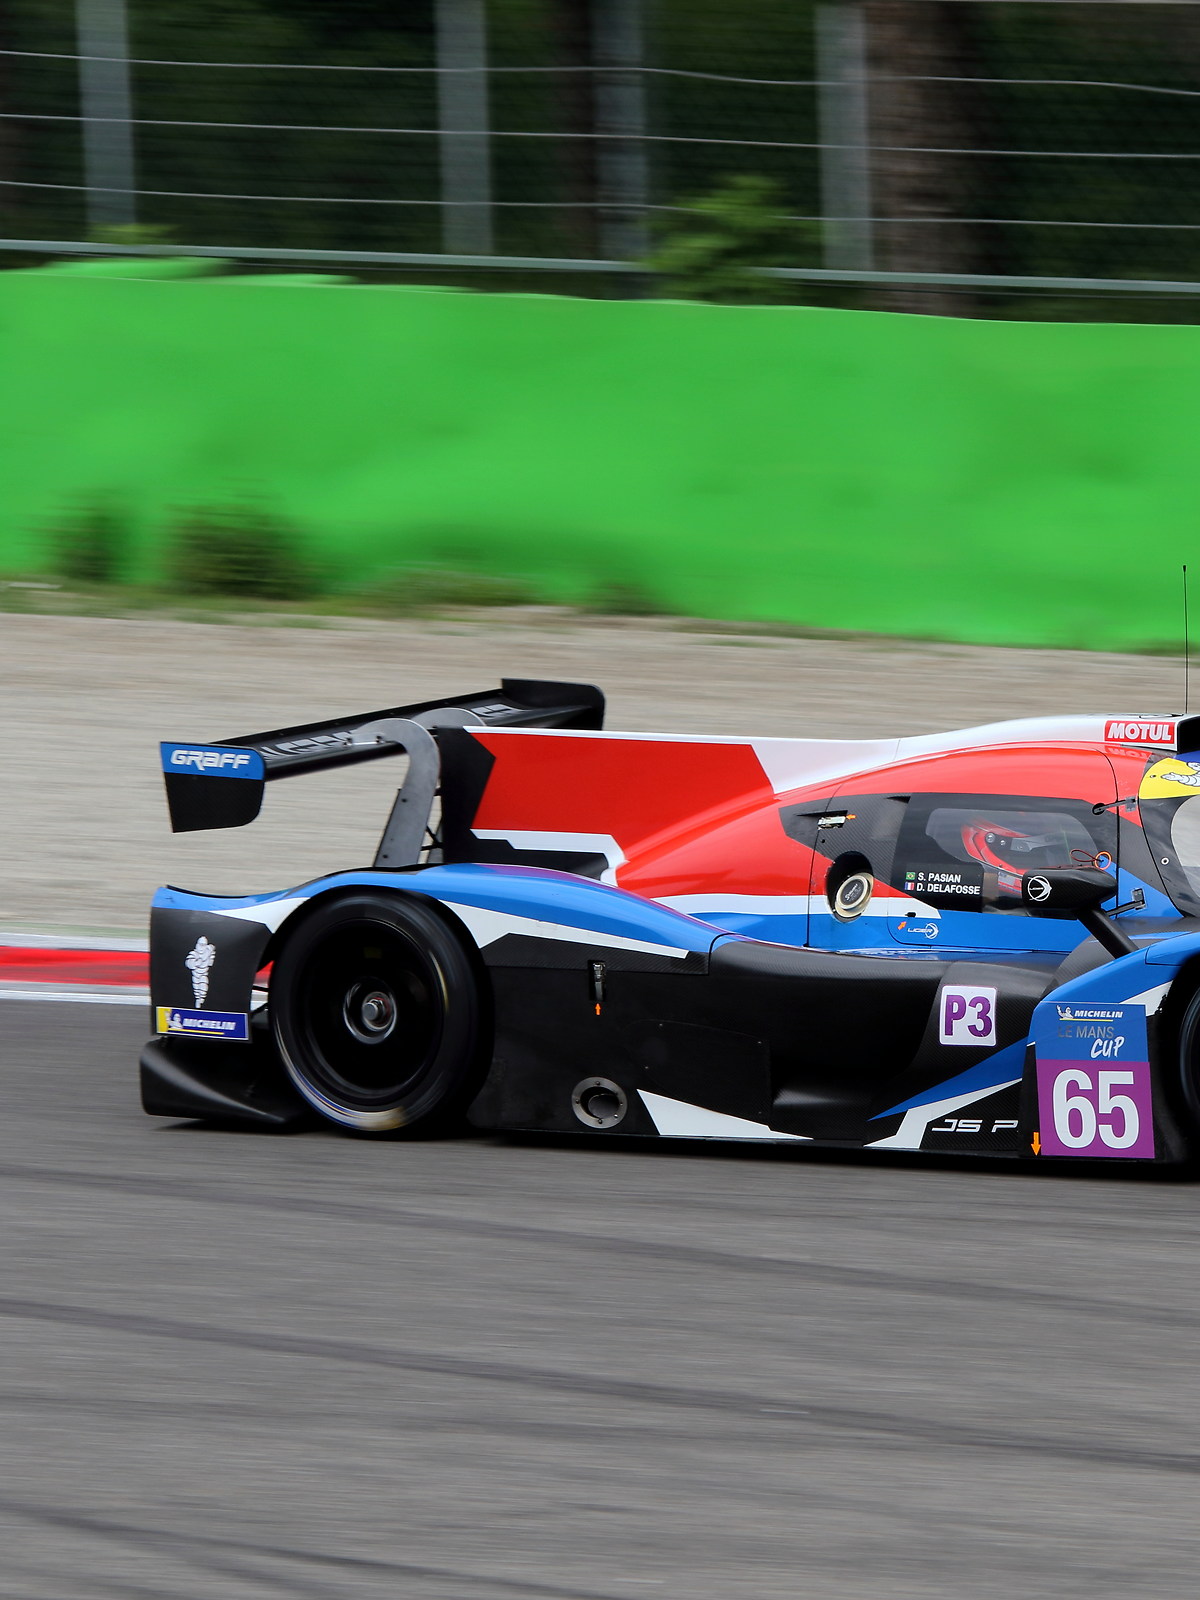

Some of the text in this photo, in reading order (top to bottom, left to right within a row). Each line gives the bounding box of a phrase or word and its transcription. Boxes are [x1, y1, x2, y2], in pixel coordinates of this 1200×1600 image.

[1107, 722, 1172, 741] MOTUL
[170, 749, 251, 771] GRAFF
[917, 872, 962, 883] S. PASIAN
[916, 883, 981, 895] D. DELAFOSSE
[944, 994, 993, 1038] P3
[1074, 1010, 1124, 1018] MICHELIN
[182, 1018, 237, 1031] MICHELIN
[1058, 1025, 1115, 1039] LE MANS
[1090, 1036, 1125, 1058] CUP
[1053, 1069, 1140, 1149] 65
[931, 1119, 983, 1133] JS
